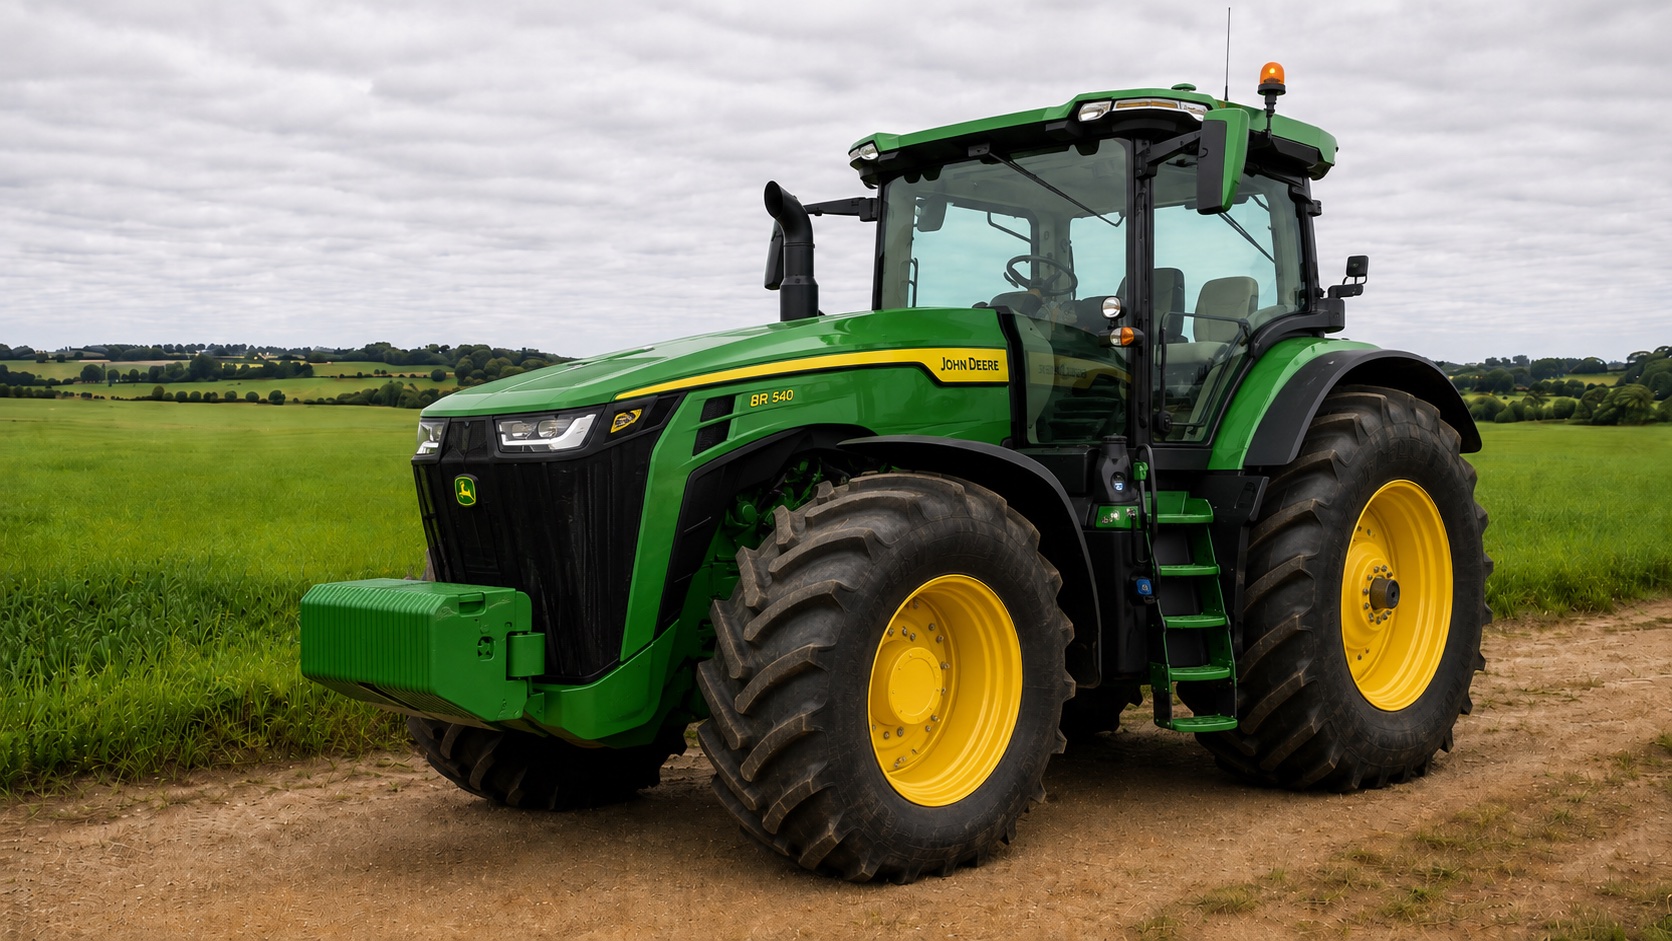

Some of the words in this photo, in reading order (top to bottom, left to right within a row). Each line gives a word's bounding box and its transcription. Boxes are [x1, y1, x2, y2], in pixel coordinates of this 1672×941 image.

[941, 357, 967, 371] JOHN
[968, 357, 999, 371] DEERE
[772, 389, 794, 403] 540
